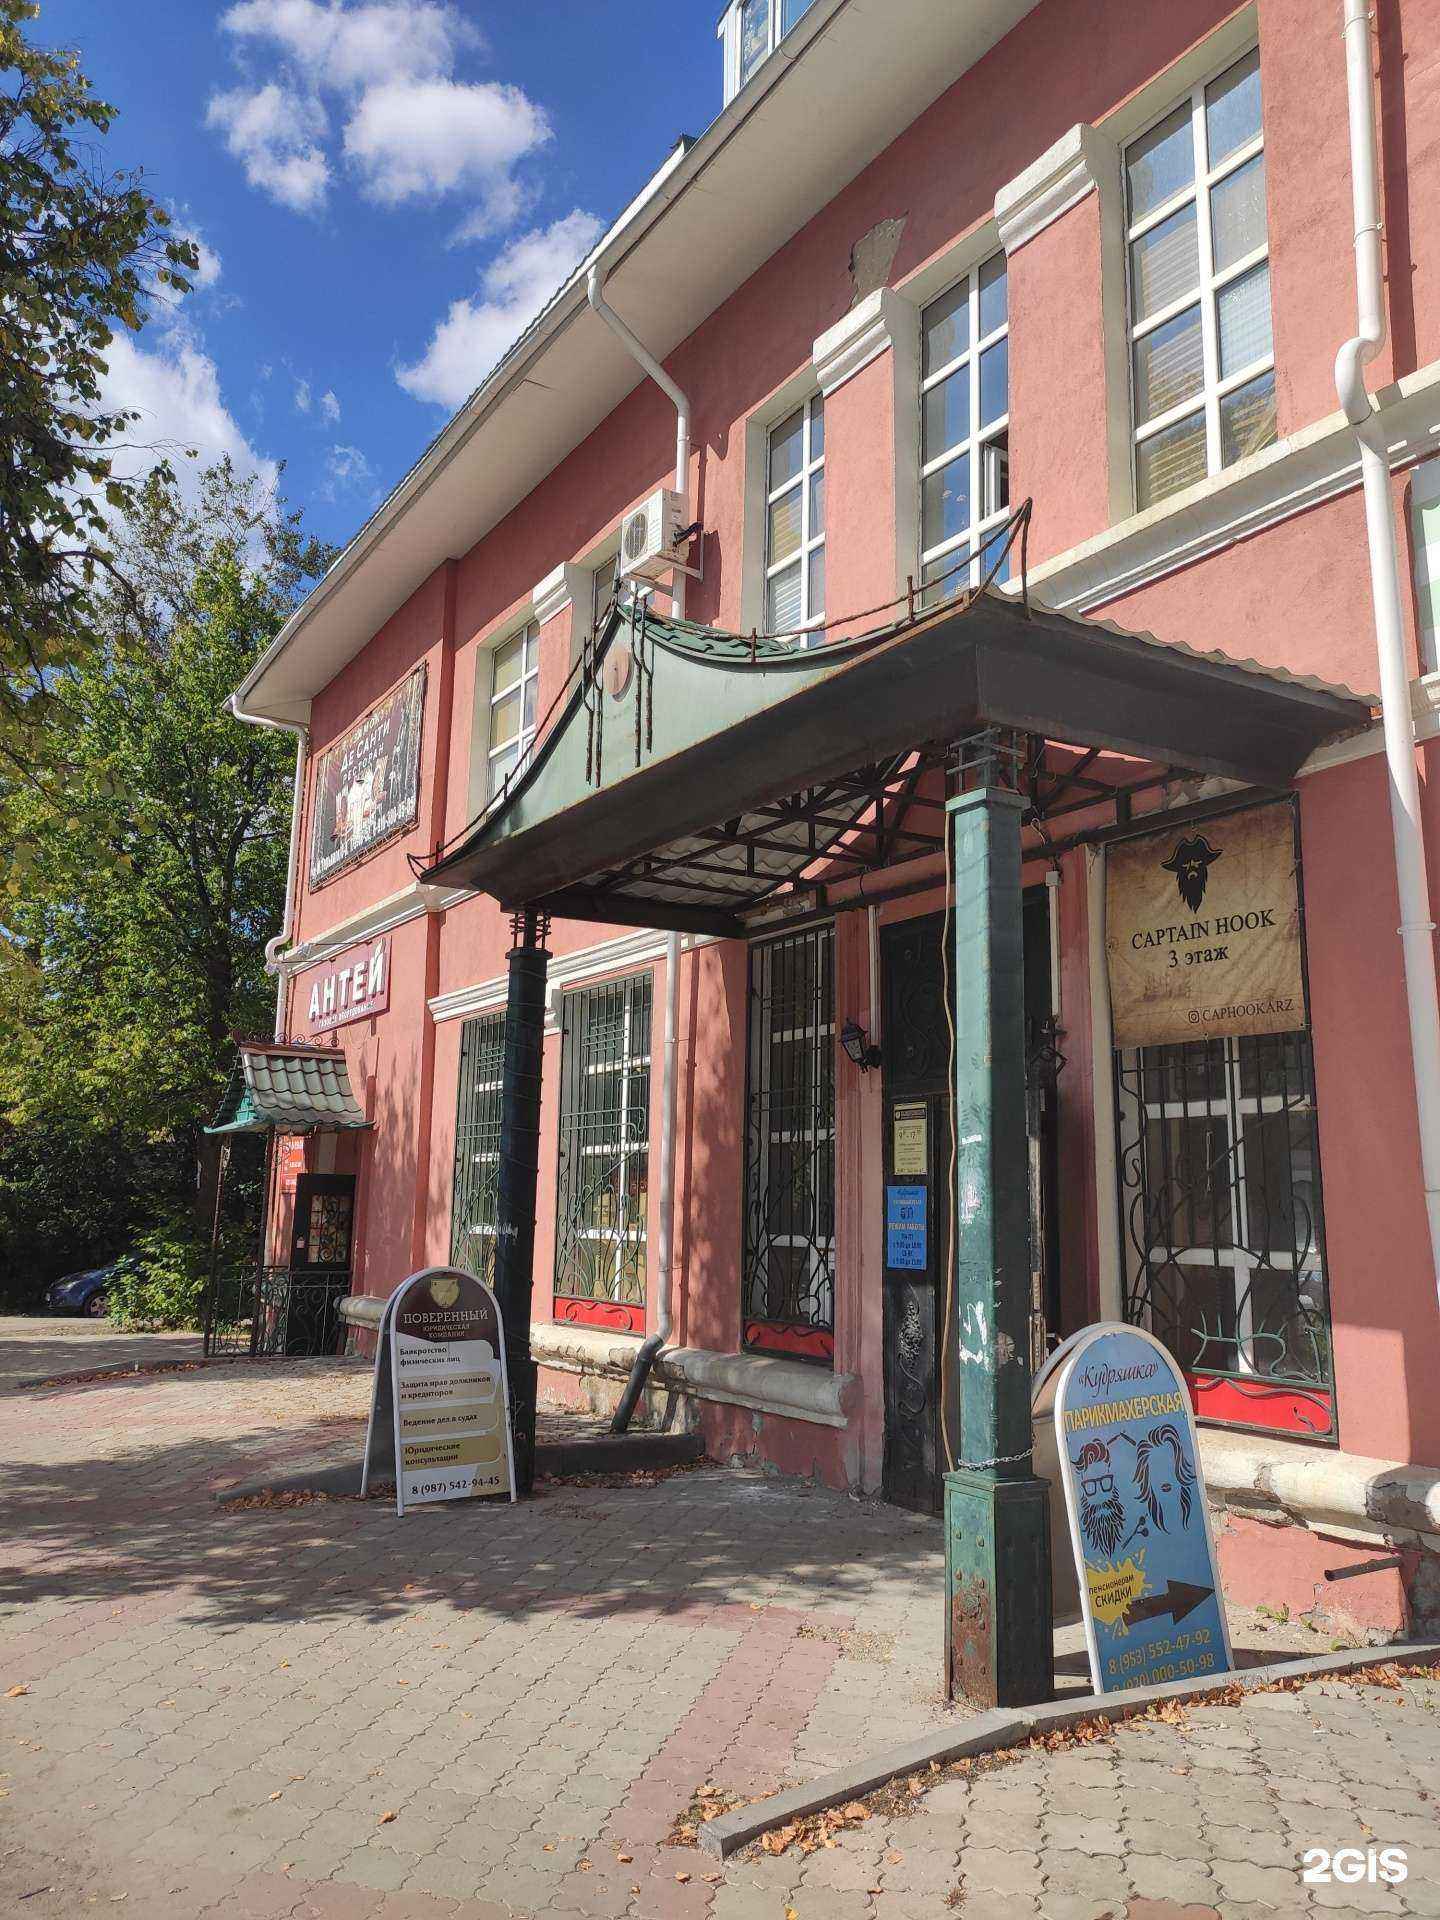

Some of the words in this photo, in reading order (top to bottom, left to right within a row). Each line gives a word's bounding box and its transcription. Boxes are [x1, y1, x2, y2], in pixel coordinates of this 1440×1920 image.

[357, 718, 390, 758] САНТИ
[343, 742, 384, 785] РЕСТОРАН
[1131, 920, 1210, 949] CAPTAIN
[1215, 909, 1276, 935] HOOK
[1168, 950, 1179, 968] 3
[1185, 945, 1229, 965] этаж
[308, 937, 385, 1021] АНТЕЙ
[1203, 998, 1294, 1022] CAPHOOKARZ
[402, 1307, 489, 1324] ПОВЕРЕННЫЙ
[424, 1323, 470, 1332] ЮРИДИЧЕСКАЯ
[400, 1346, 447, 1357] Банкротство
[400, 1380, 428, 1389] Защита
[430, 1380, 448, 1389] прав
[449, 1376, 491, 1386] должников
[403, 1418, 435, 1427] Ведение
[437, 1416, 450, 1425] дел
[458, 1414, 478, 1424] судах
[1063, 1391, 1184, 1432] ПАРИКМАХЕРСКАЯ
[405, 1443, 460, 1455] Юридические
[405, 1455, 458, 1466] консультации
[411, 1486, 418, 1494] 8
[421, 1482, 446, 1495] (987)
[449, 1475, 500, 1490] 542-94-45
[1089, 1574, 1134, 1595] пенсионерам
[1095, 1585, 1132, 1608] СКИДКИ
[1108, 1659, 1117, 1674] 8
[1120, 1647, 1146, 1673] (953)
[1148, 1629, 1211, 1659] 552-47-92
